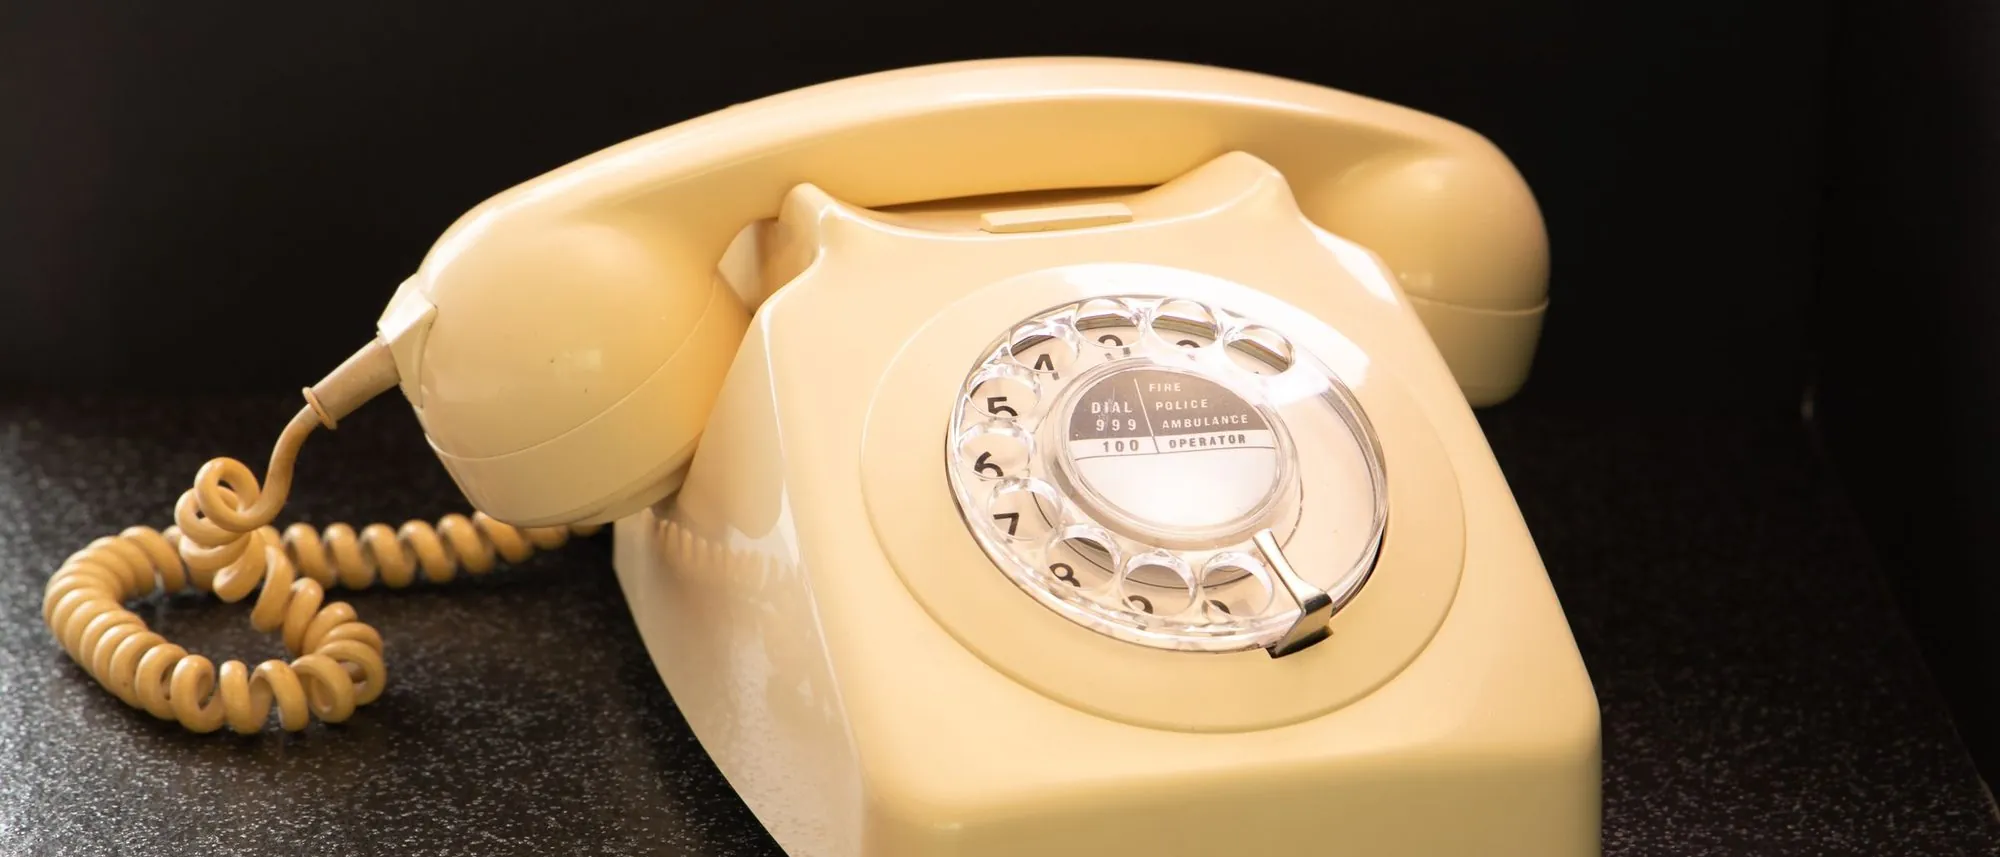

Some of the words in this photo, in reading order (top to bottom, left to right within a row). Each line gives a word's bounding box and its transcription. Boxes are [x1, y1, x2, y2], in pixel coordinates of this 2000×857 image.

[1149, 383, 1182, 393] FIRE
[1091, 401, 1133, 414] DIAL
[1155, 399, 1209, 411] POLICE
[1162, 414, 1249, 429] AMBULANCE
[1169, 434, 1247, 449] OPERATOR
[993, 512, 1020, 543] 7
